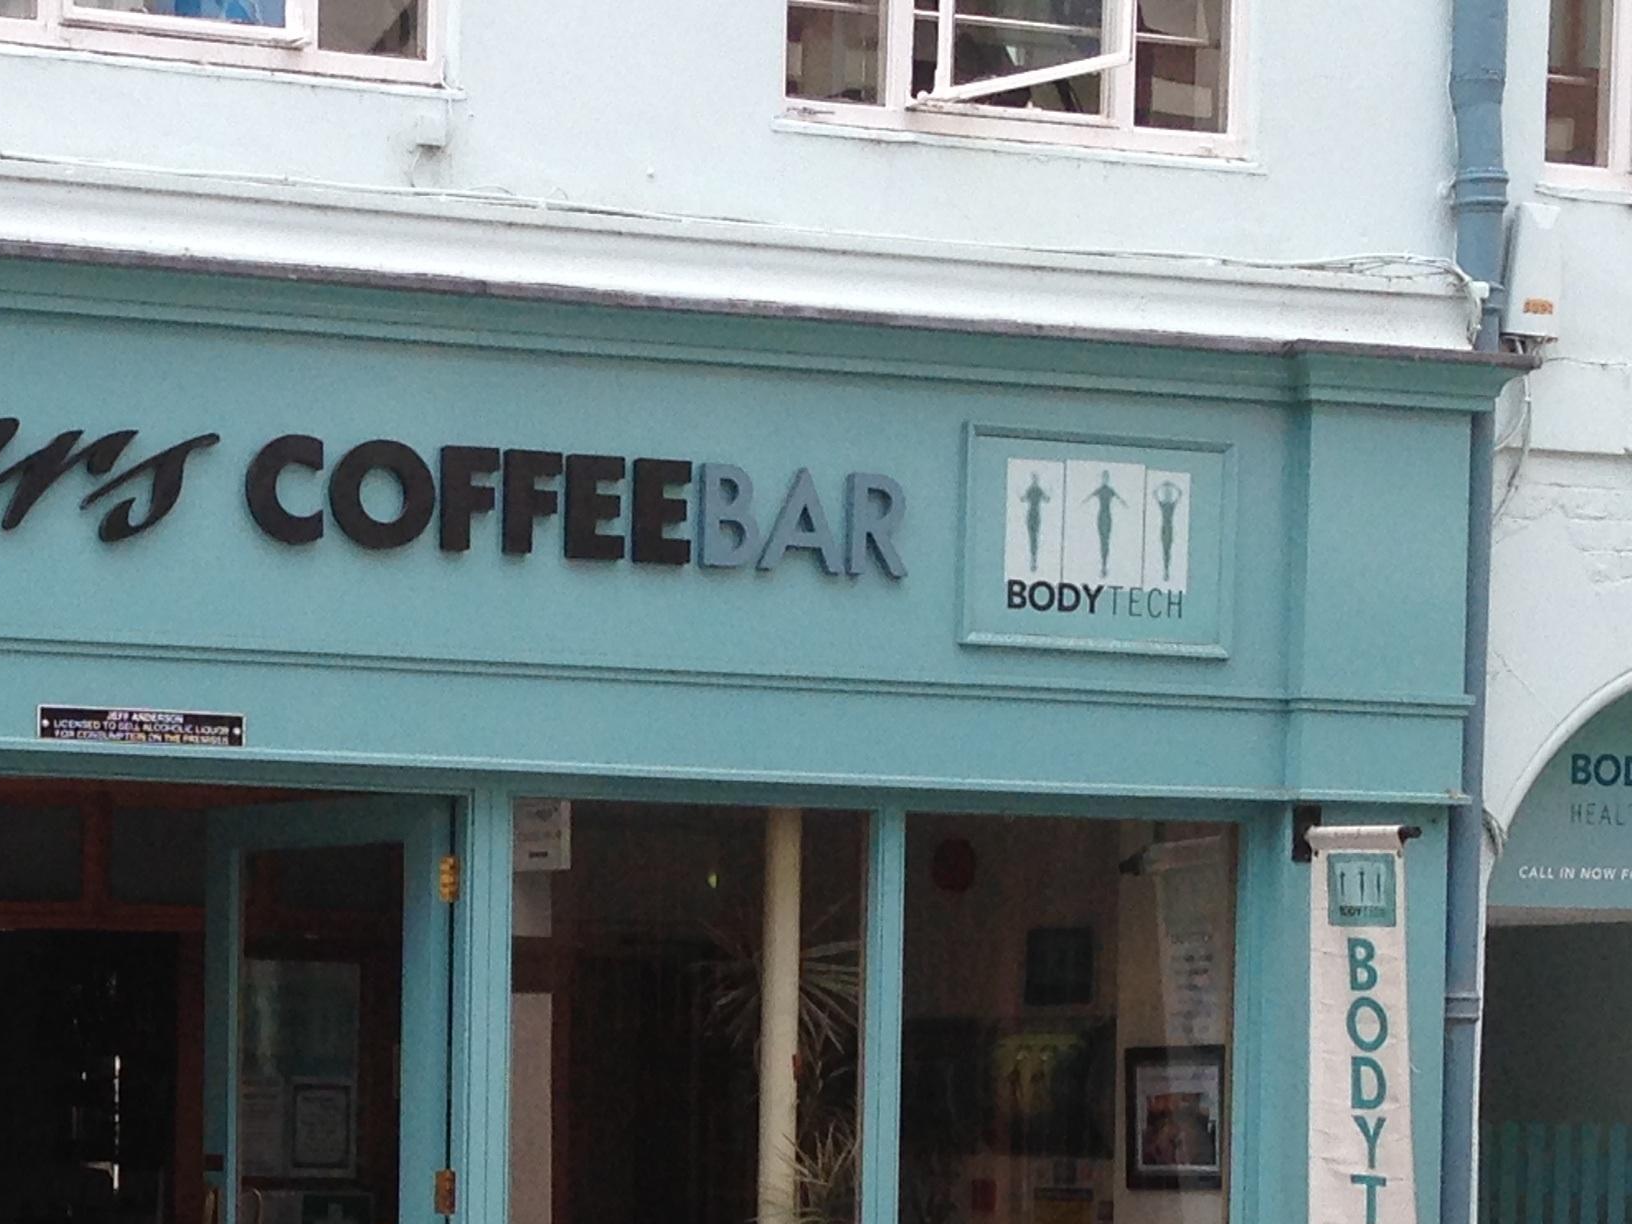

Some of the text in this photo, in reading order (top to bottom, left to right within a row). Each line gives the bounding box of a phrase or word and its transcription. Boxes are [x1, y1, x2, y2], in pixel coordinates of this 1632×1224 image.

[53, 719, 101, 730] LICENSED
[102, 721, 116, 730] TO
[142, 723, 193, 734] ALCOHOLIC
[1571, 753, 1632, 787] BO
[1570, 803, 1632, 826] HEAL
[1518, 866, 1555, 879] CALL
[1559, 867, 1576, 879] IN
[1579, 867, 1617, 881] NOW
